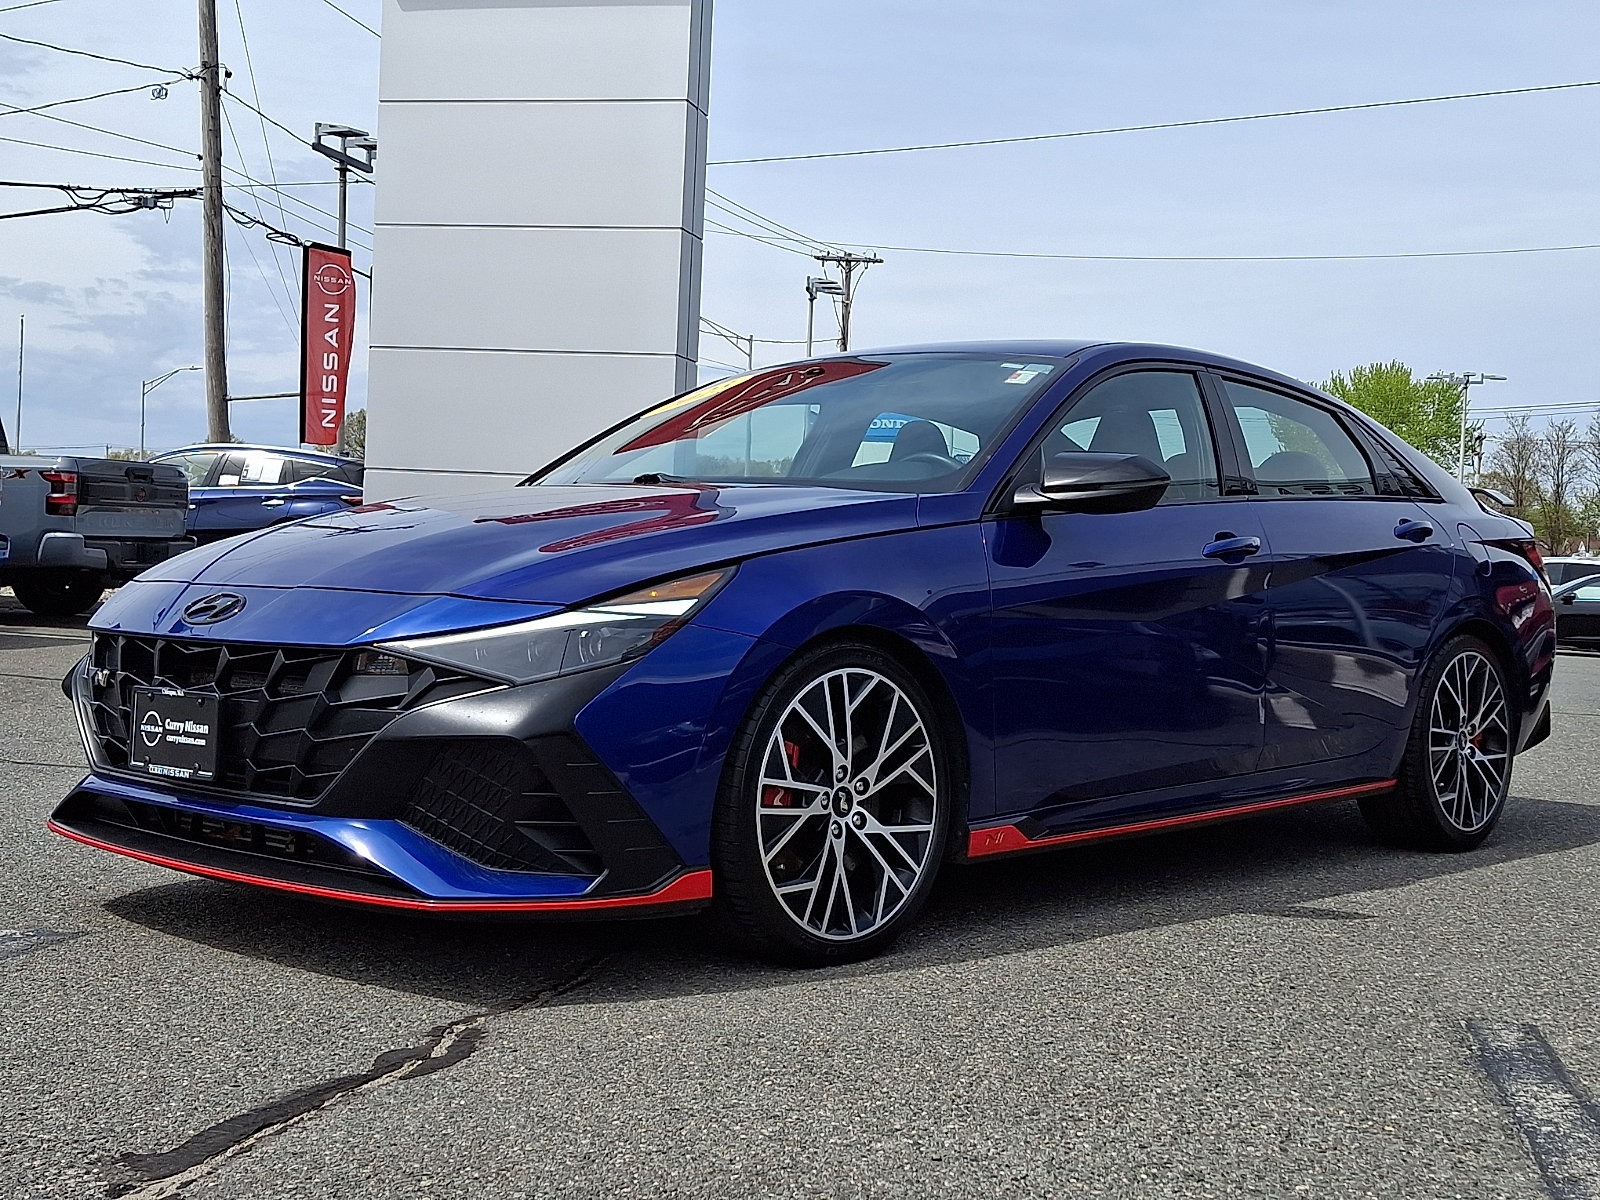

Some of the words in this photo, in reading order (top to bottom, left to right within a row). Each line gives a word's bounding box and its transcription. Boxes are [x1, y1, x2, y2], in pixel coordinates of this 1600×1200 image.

[313, 274, 352, 286] NISSAN
[321, 303, 340, 428] NISSAN
[140, 724, 163, 733] NISSAN
[164, 717, 184, 734] Curry
[185, 720, 209, 735] Nissan
